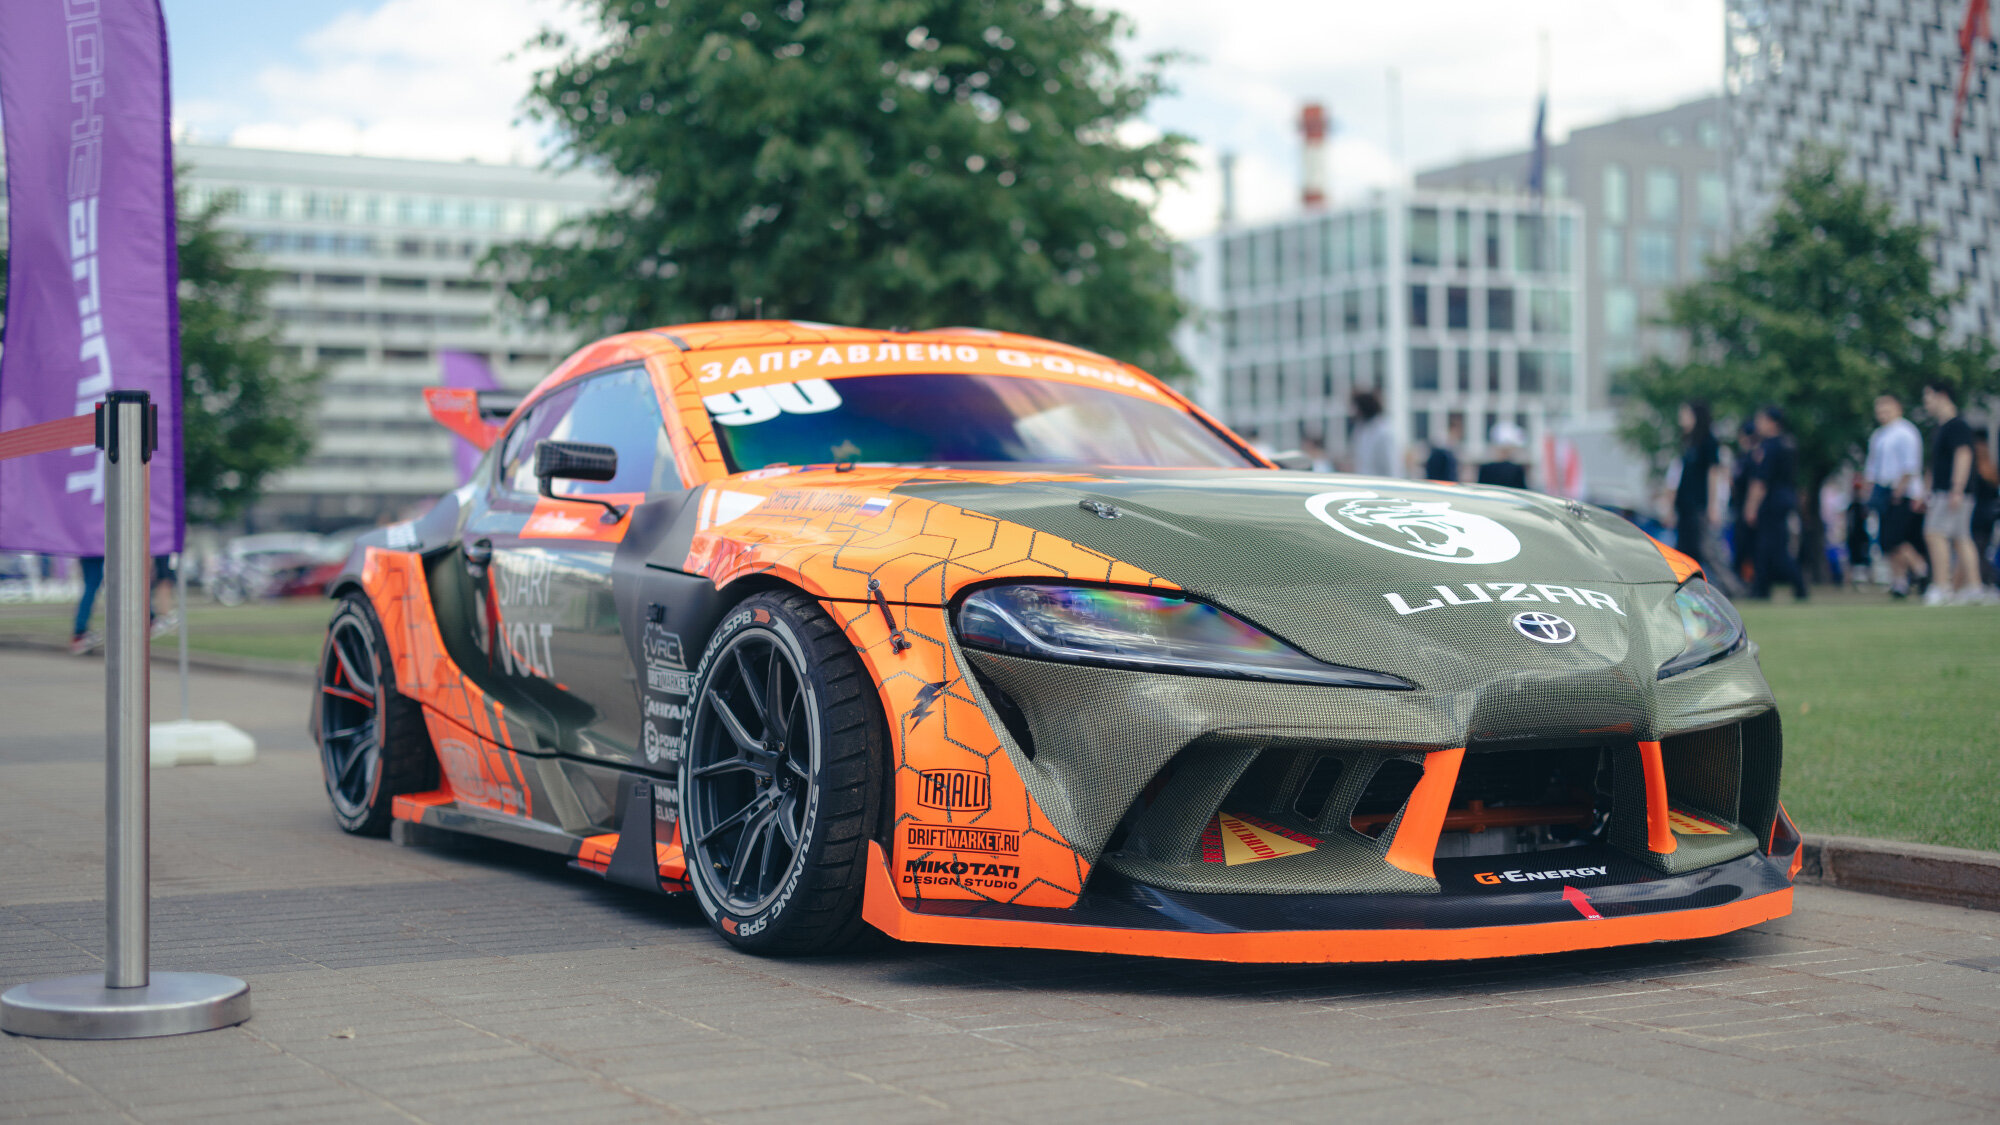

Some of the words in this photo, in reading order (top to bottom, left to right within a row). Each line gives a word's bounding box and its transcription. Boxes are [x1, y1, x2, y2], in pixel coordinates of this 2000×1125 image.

[698, 343, 979, 383] ЗАПРАВЛЕНО
[701, 378, 843, 426] 90
[500, 551, 560, 606] START
[1382, 583, 1627, 616] LUZAR
[497, 621, 554, 678] VOLT
[648, 636, 679, 661] VRC
[924, 772, 987, 807] TRIALLI
[907, 828, 1020, 852] DRIFTMARKET.RU
[902, 875, 959, 887] DESIGN
[963, 878, 1018, 890] STUDIO
[905, 860, 1020, 879] MIKOTATI
